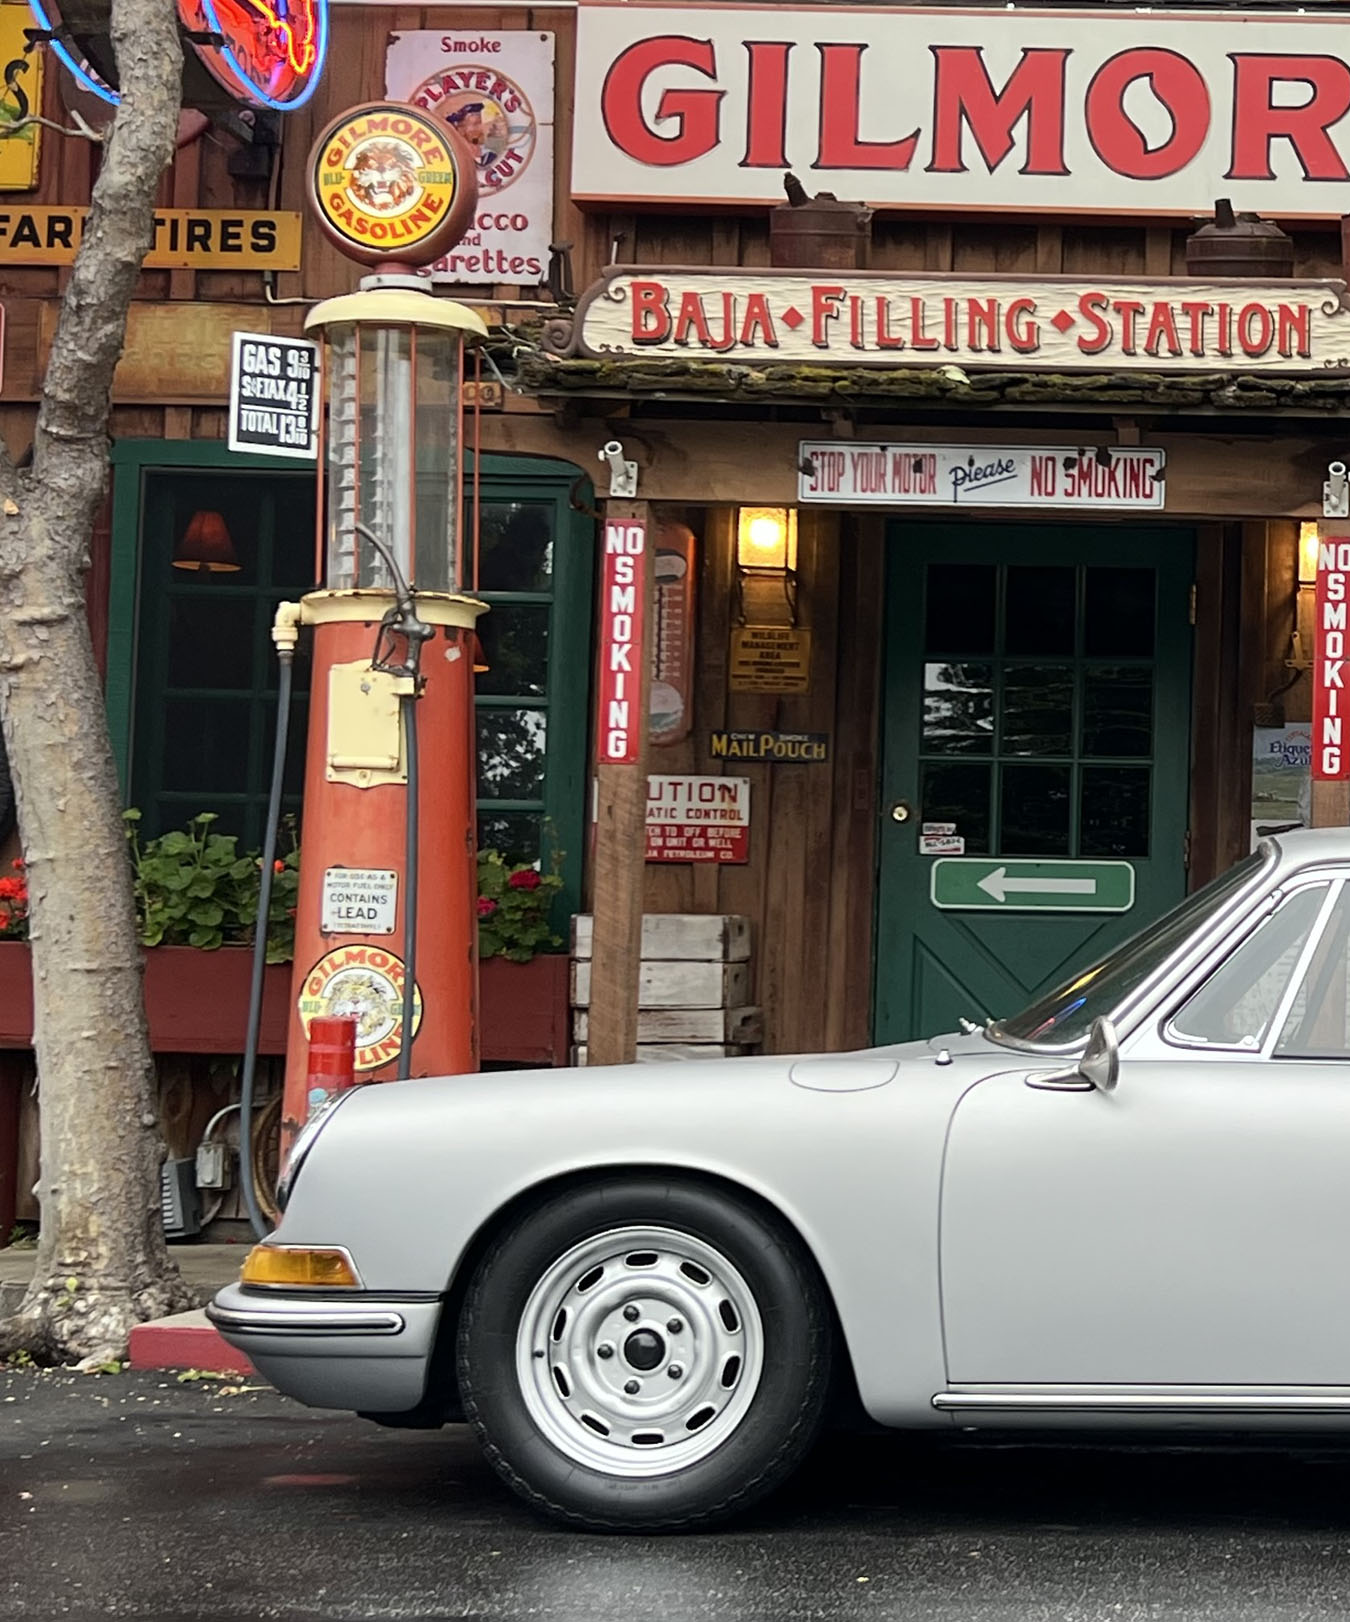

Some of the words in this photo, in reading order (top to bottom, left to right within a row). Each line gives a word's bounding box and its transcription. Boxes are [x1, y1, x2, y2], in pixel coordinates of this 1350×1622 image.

[441, 37, 501, 53] Smoke
[326, 117, 445, 168] GILMORE
[484, 147, 523, 187] CUT
[329, 193, 444, 239] GASOLINE
[629, 281, 781, 350] BAJA
[812, 286, 1038, 352] FILLING
[1076, 292, 1312, 358] STATION
[243, 343, 281, 376] GAS
[241, 409, 279, 434] TOTAL
[810, 451, 845, 493] STOP
[850, 453, 887, 494] YOUR
[892, 453, 937, 495] MOTOR
[950, 459, 1016, 503] please
[1031, 455, 1055, 496] NO
[1064, 456, 1156, 499] SMOKING
[607, 525, 643, 555] NO
[711, 734, 759, 757] MAIL
[760, 734, 825, 759] POUCH
[647, 782, 739, 803] UTION
[686, 808, 744, 821] CONTROL
[665, 826, 677, 837] TO
[684, 826, 701, 837] OFF
[692, 838, 705, 848] OR
[708, 839, 732, 849] WELL
[330, 893, 388, 905] CONTAINS
[353, 882, 372, 890] FUEL
[338, 907, 378, 920] LEAD
[308, 950, 405, 996] GILMOR
